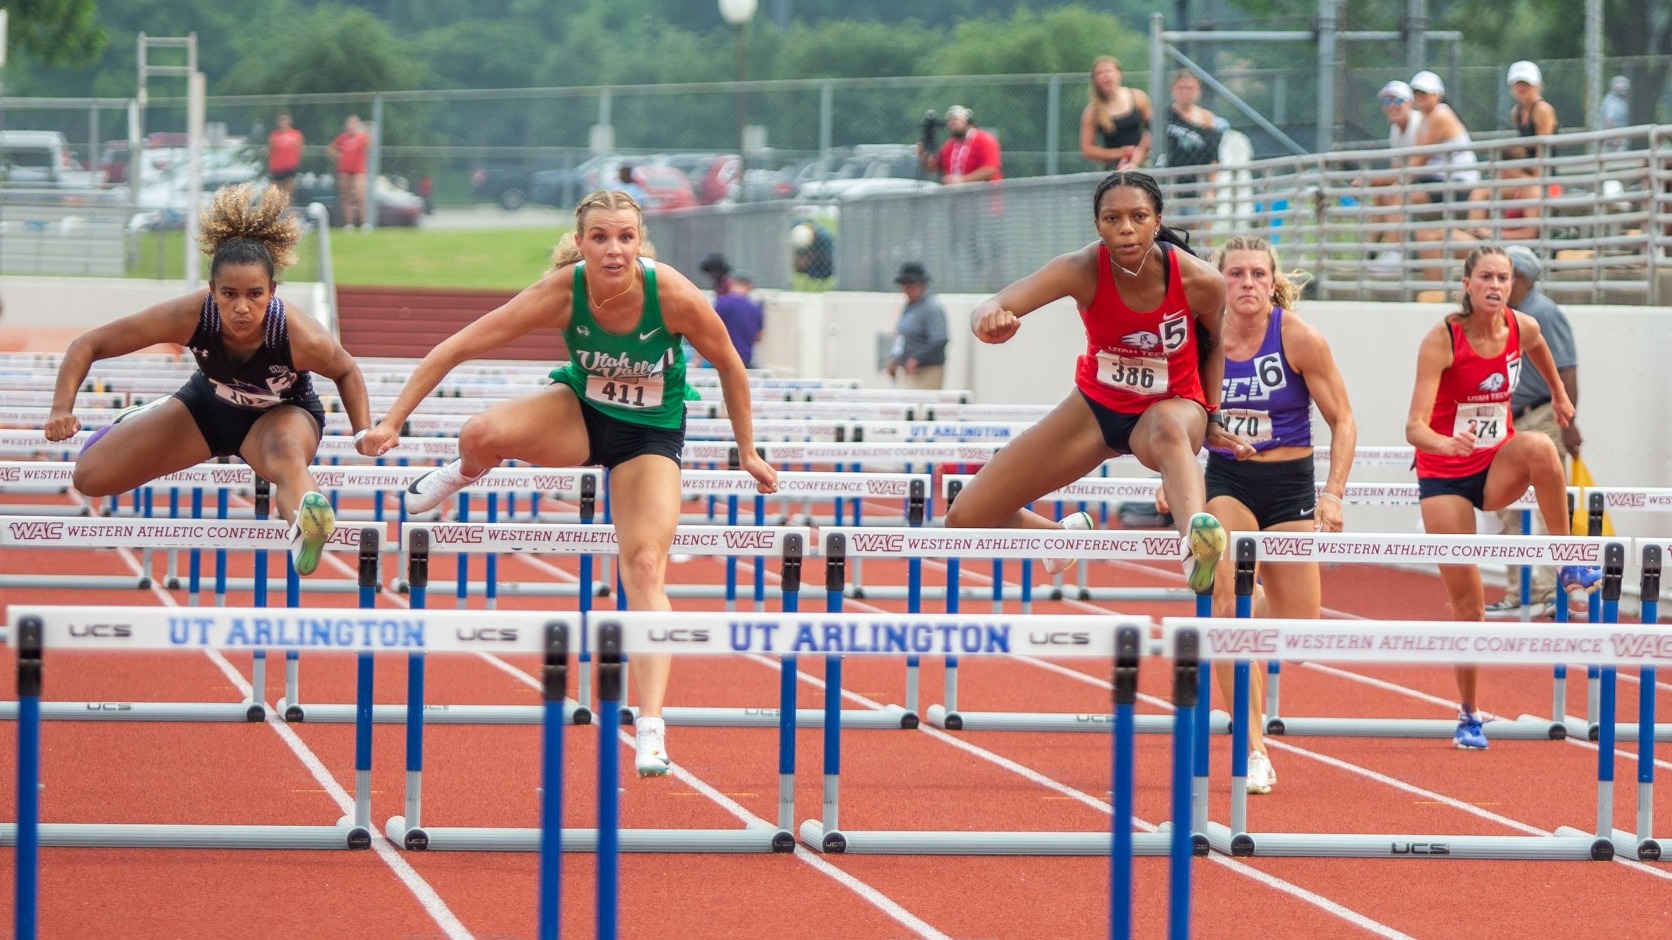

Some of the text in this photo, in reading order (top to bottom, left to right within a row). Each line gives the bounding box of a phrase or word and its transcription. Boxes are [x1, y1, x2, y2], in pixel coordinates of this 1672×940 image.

[1165, 318, 1186, 349] 5
[1108, 345, 1138, 354] UTAH
[576, 350, 630, 370] Utah
[597, 360, 655, 379] Valle
[1111, 362, 1155, 389] 386
[1258, 356, 1283, 387] 6
[602, 382, 645, 407] 411
[0, 467, 21, 482] AC
[211, 469, 252, 484] WAC
[347, 475, 399, 486] WESTERN
[533, 475, 575, 490] WAC
[682, 480, 733, 489] WESTERN
[789, 480, 863, 491] CONFERENCE
[866, 480, 907, 495] WAC
[1064, 485, 1115, 495] ATHLETIC
[1345, 488, 1384, 497] ESTERN
[1606, 492, 1646, 507] WAC
[10, 522, 63, 540] WAC
[67, 525, 133, 538] WESTERN
[136, 526, 204, 539] ATHLETIC
[325, 527, 361, 547] AC
[431, 526, 484, 544] WAC
[487, 530, 553, 543] WESTERN
[673, 534, 718, 547] RENCE
[723, 531, 775, 550] WAC
[852, 534, 904, 553] WAC
[908, 538, 971, 550] WESTERN
[975, 539, 1041, 551] ATHLETIC
[1044, 539, 1138, 553] CONFERENCE
[1262, 537, 1600, 562] WAC WESTERN ATHLETIC CONFERENCE WAC
[68, 618, 518, 647] UCS UT ARLINGTON UCS
[647, 622, 1090, 654] UCS UT ARLINGTON UCS
[1207, 628, 1280, 654] WAC
[1285, 630, 1372, 650] WESTERN
[1378, 633, 1469, 652] ATHLETIC
[1474, 635, 1604, 654] CONFERENCE
[87, 703, 131, 711] UCS
[1391, 842, 1450, 855] UCS
